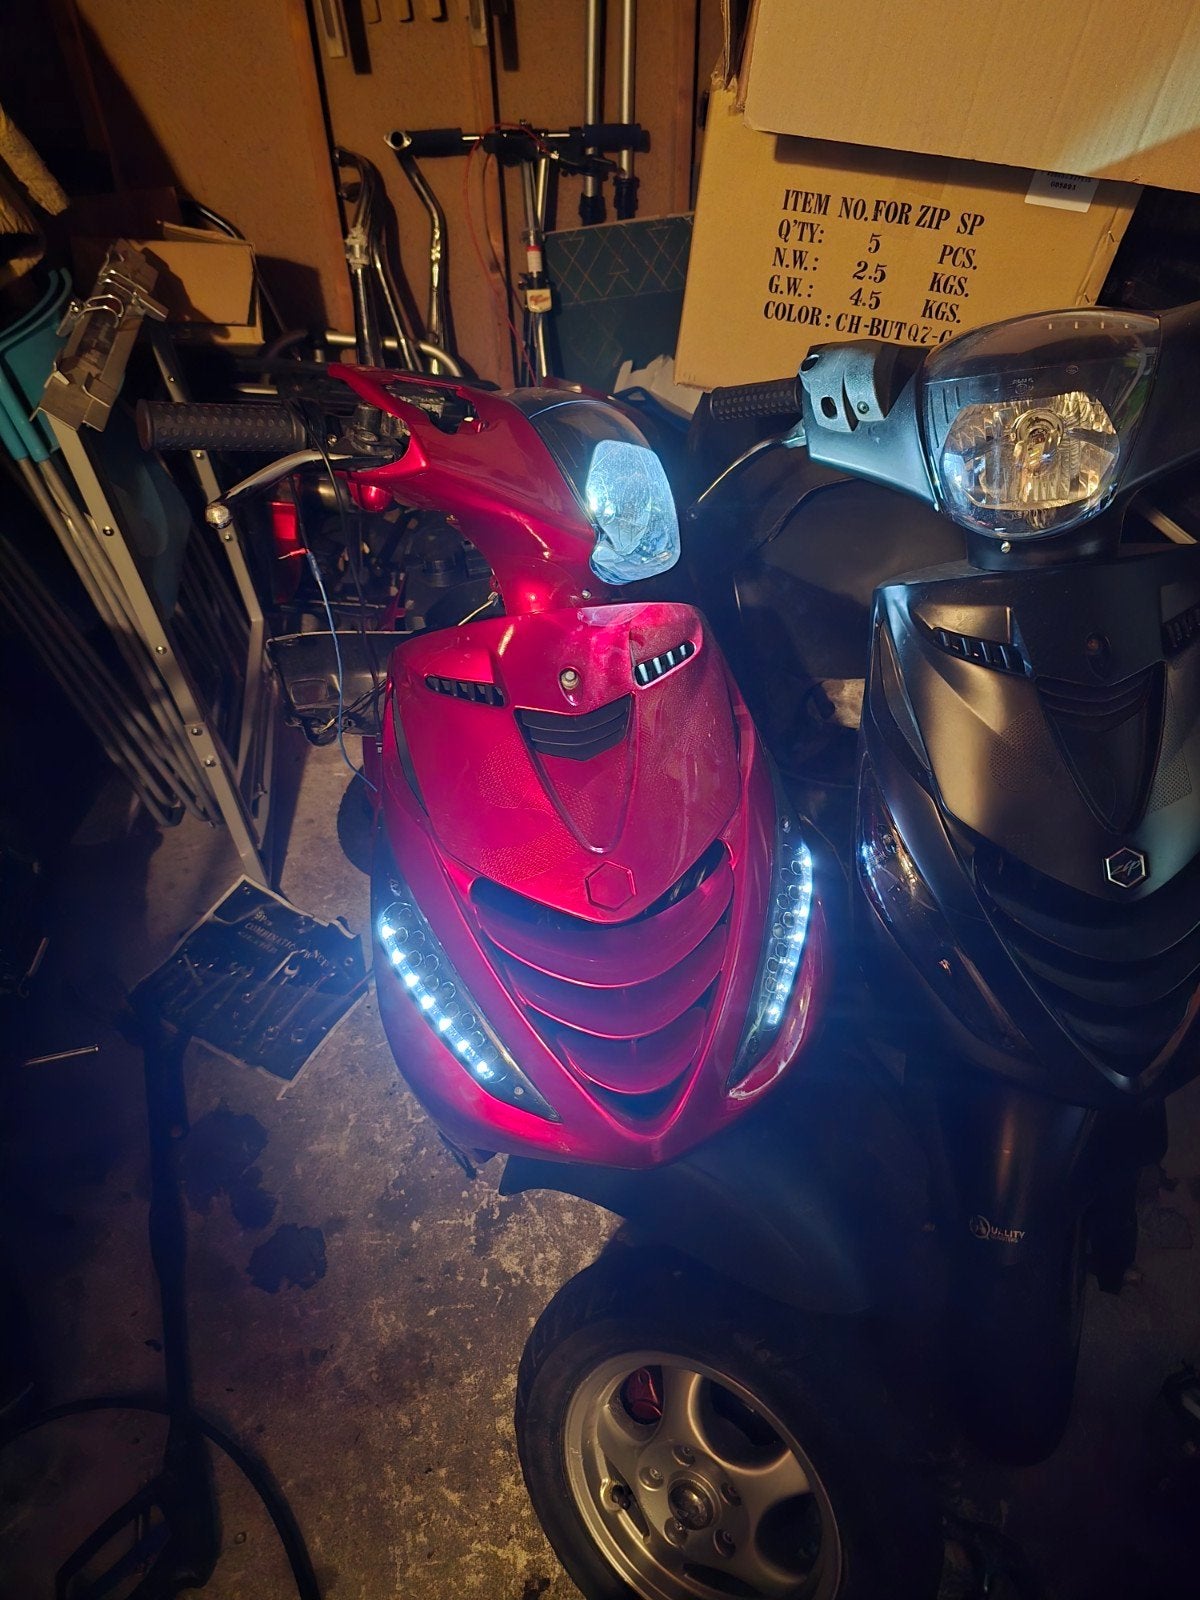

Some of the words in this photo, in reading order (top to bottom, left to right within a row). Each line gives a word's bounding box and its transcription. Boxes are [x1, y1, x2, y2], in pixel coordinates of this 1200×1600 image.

[782, 189, 831, 216] ITEM
[872, 199, 912, 226] FOR
[916, 205, 951, 230] ZIP
[956, 212, 985, 237] SP
[778, 221, 824, 244] Q'TY:
[868, 233, 881, 254] 5
[938, 245, 978, 271] PCS.
[852, 261, 886, 284] 2.5
[928, 272, 969, 298] KGS.
[849, 288, 882, 310] 4.5
[921, 299, 962, 324] KGS.
